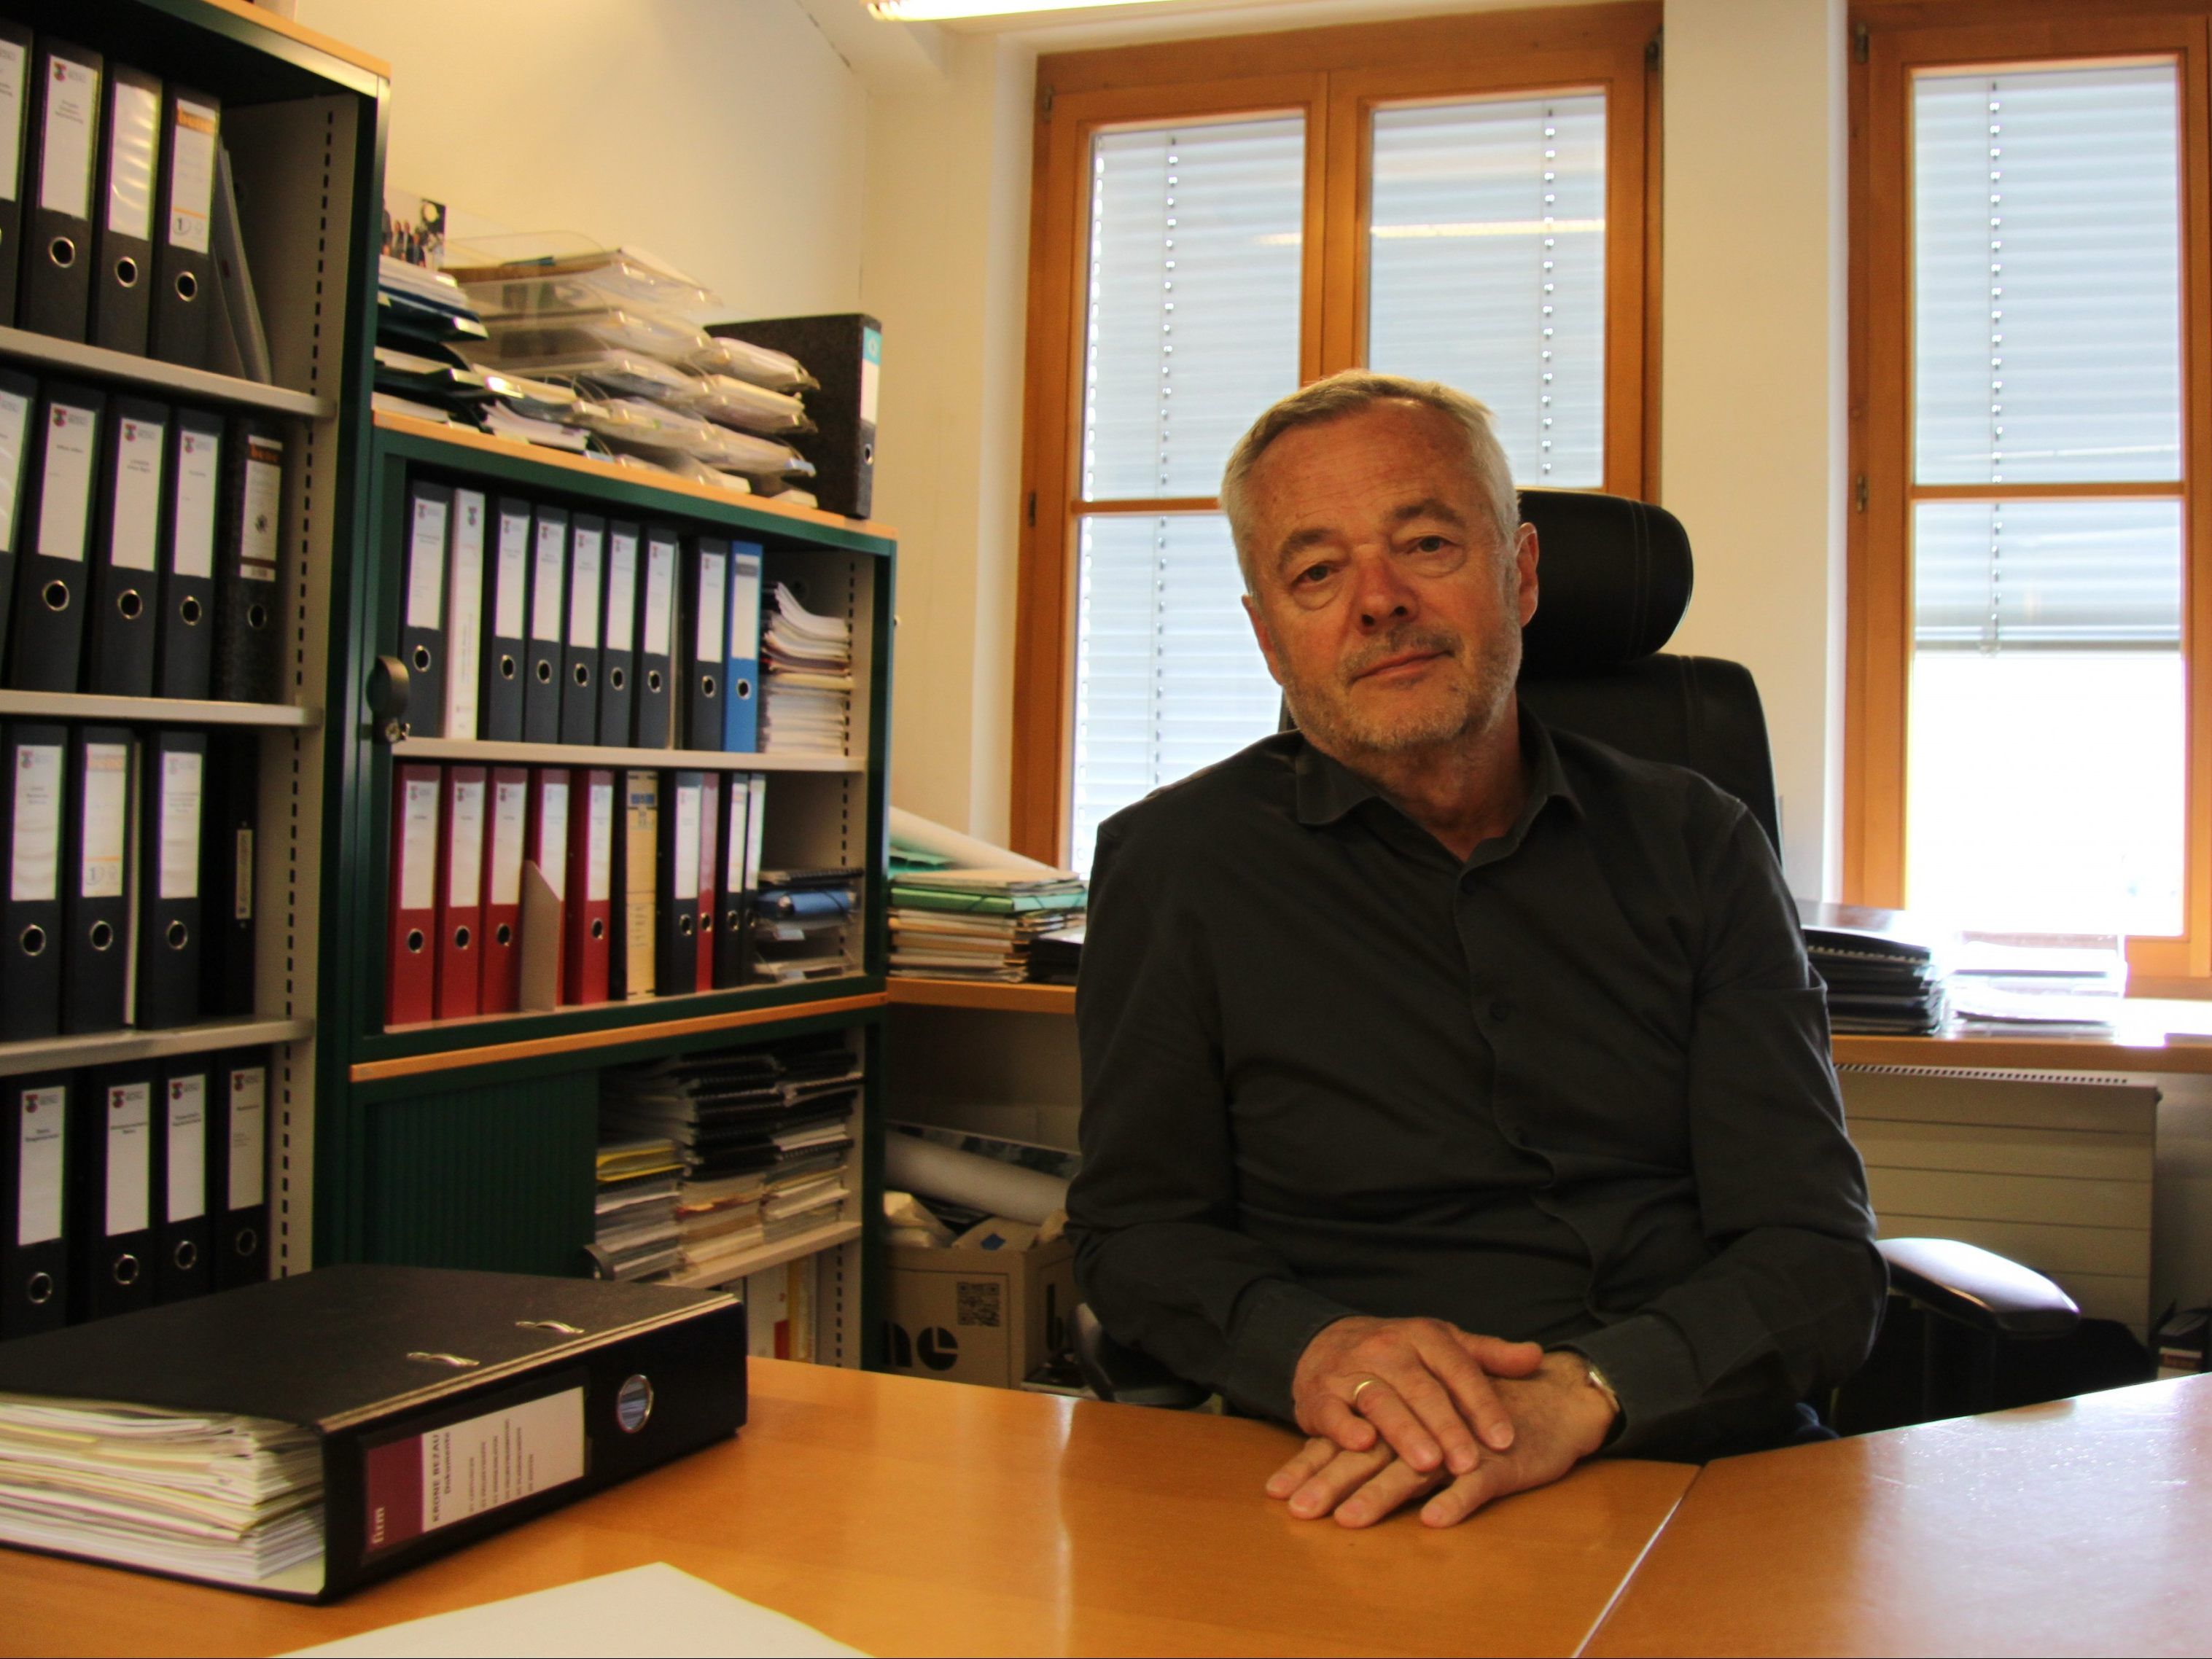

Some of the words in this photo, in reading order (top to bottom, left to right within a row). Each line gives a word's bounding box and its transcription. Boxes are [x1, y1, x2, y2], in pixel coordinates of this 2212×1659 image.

[432, 1434, 440, 1477] BEZAU
[443, 1432, 451, 1495] Dokumente
[432, 1480, 440, 1523] KRONE
[371, 1506, 386, 1544] firm
